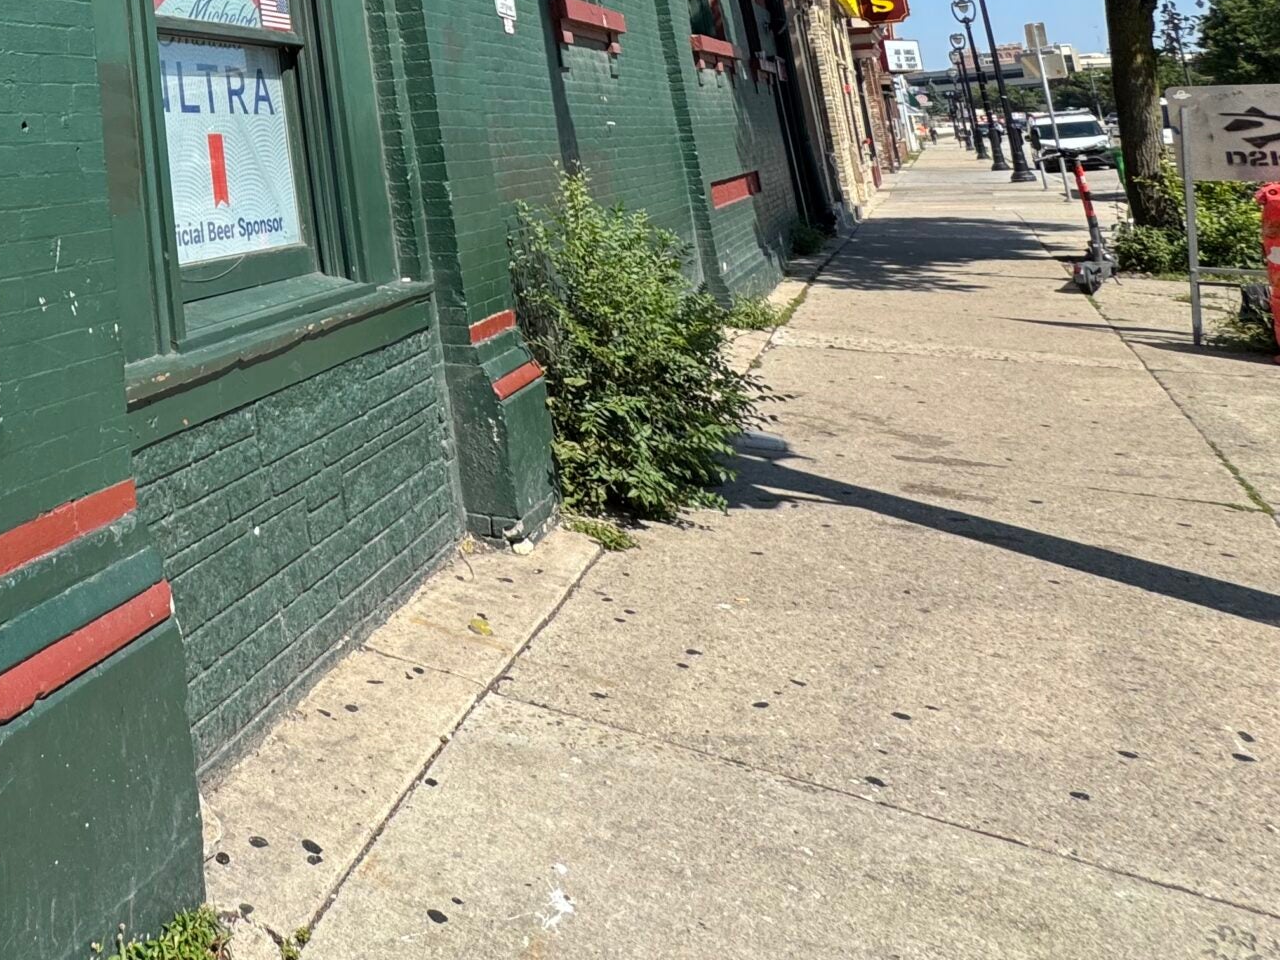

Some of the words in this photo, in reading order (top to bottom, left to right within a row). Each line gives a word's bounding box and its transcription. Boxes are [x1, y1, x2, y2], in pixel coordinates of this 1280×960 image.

[175, 221, 205, 247] icial
[207, 221, 235, 242] Beer
[237, 216, 283, 242] Sponsor
